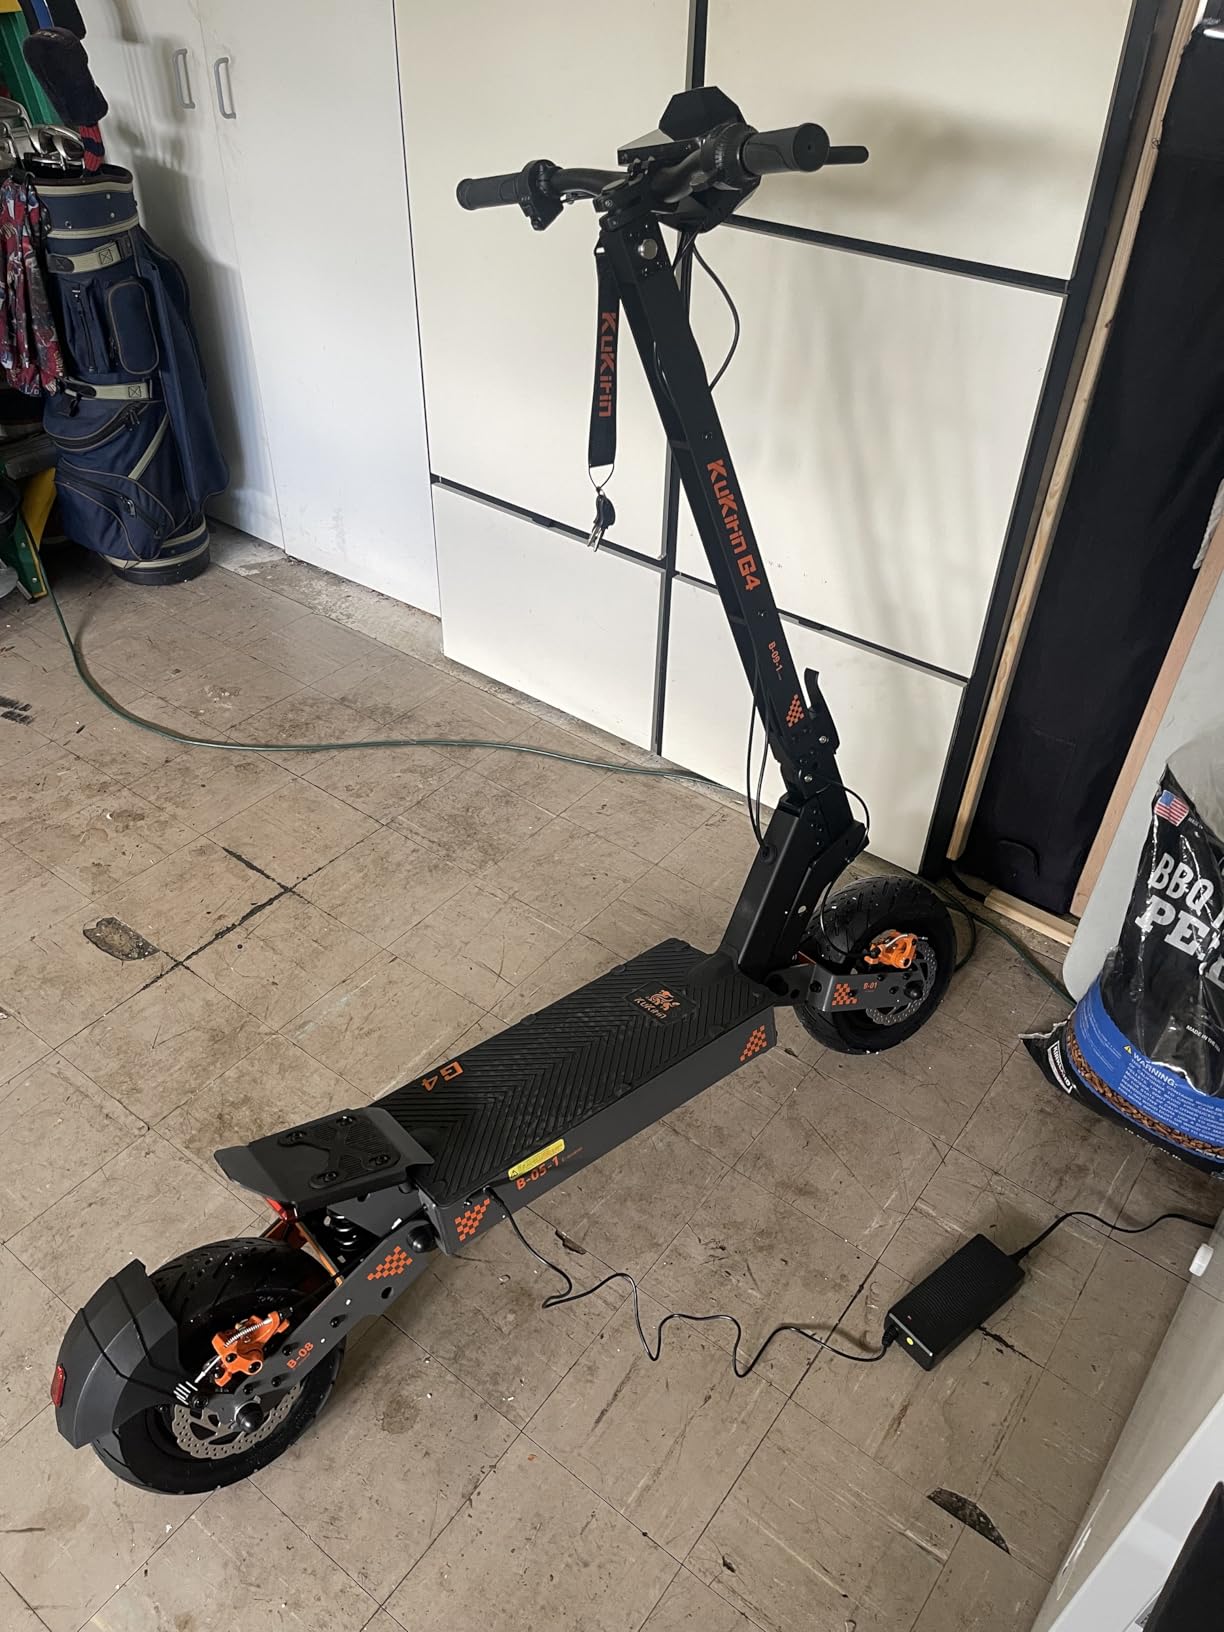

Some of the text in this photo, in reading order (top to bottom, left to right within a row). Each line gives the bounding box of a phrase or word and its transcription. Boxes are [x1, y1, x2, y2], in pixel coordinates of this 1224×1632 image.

[706, 459, 761, 592] KuKirin G4
[768, 640, 783, 672] B-09-1
[1149, 852, 1215, 917] BBQ
[863, 981, 878, 990] B-01
[421, 1061, 464, 1092] G4
[516, 1155, 559, 1191] B-05-1
[287, 1342, 314, 1368] B-08
